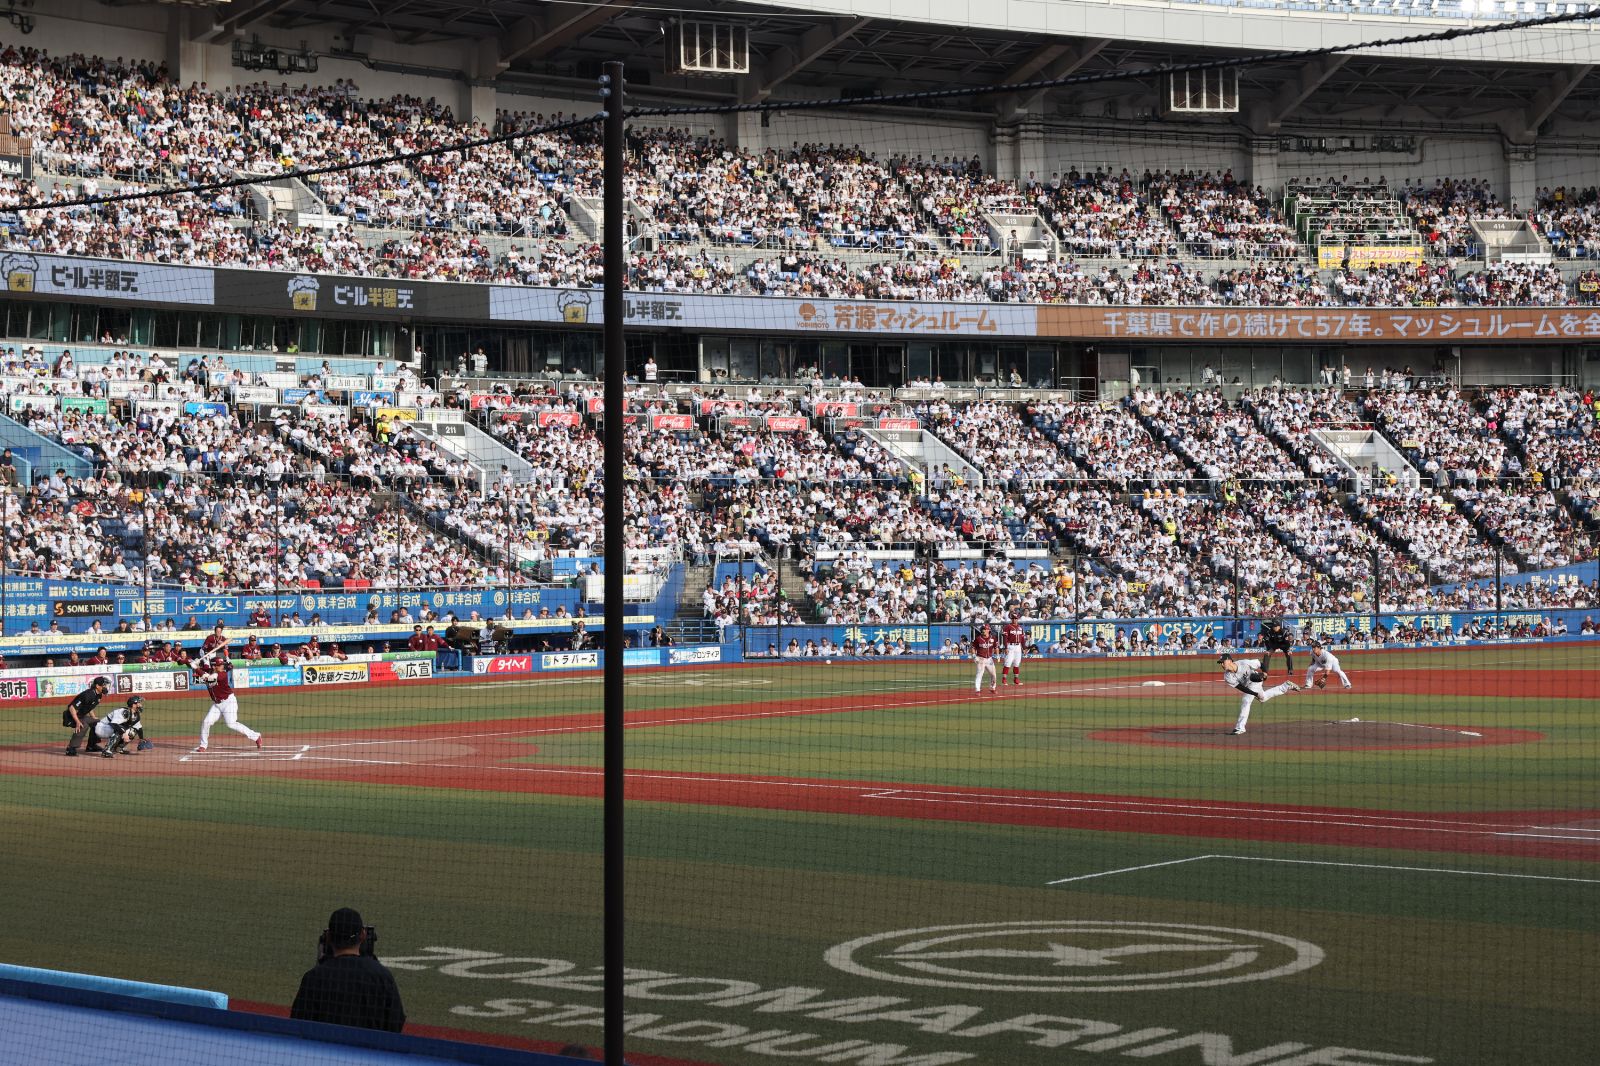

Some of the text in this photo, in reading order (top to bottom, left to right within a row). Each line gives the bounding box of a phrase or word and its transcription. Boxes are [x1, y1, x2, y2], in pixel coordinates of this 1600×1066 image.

[1336, 249, 1420, 260] ミストップアプリシート
[833, 304, 997, 332] 芳源マッシュルーム
[796, 321, 830, 329] YOSHIMOTO
[445, 426, 457, 434] 211
[1337, 434, 1350, 442] 213
[317, 596, 357, 609] 東洋合成
[382, 594, 421, 607] 東洋合成
[445, 593, 482, 606] 東洋合成
[505, 591, 541, 605] 東洋合成
[67, 604, 114, 613] SOME THING
[1420, 614, 1452, 629] 市進
[874, 628, 929, 642] 大成建設
[1163, 622, 1223, 636] CSランバー
[405, 662, 431, 678] 広宣
[498, 658, 527, 671] タイヘイ
[318, 670, 365, 682] 佐藤ケミカル
